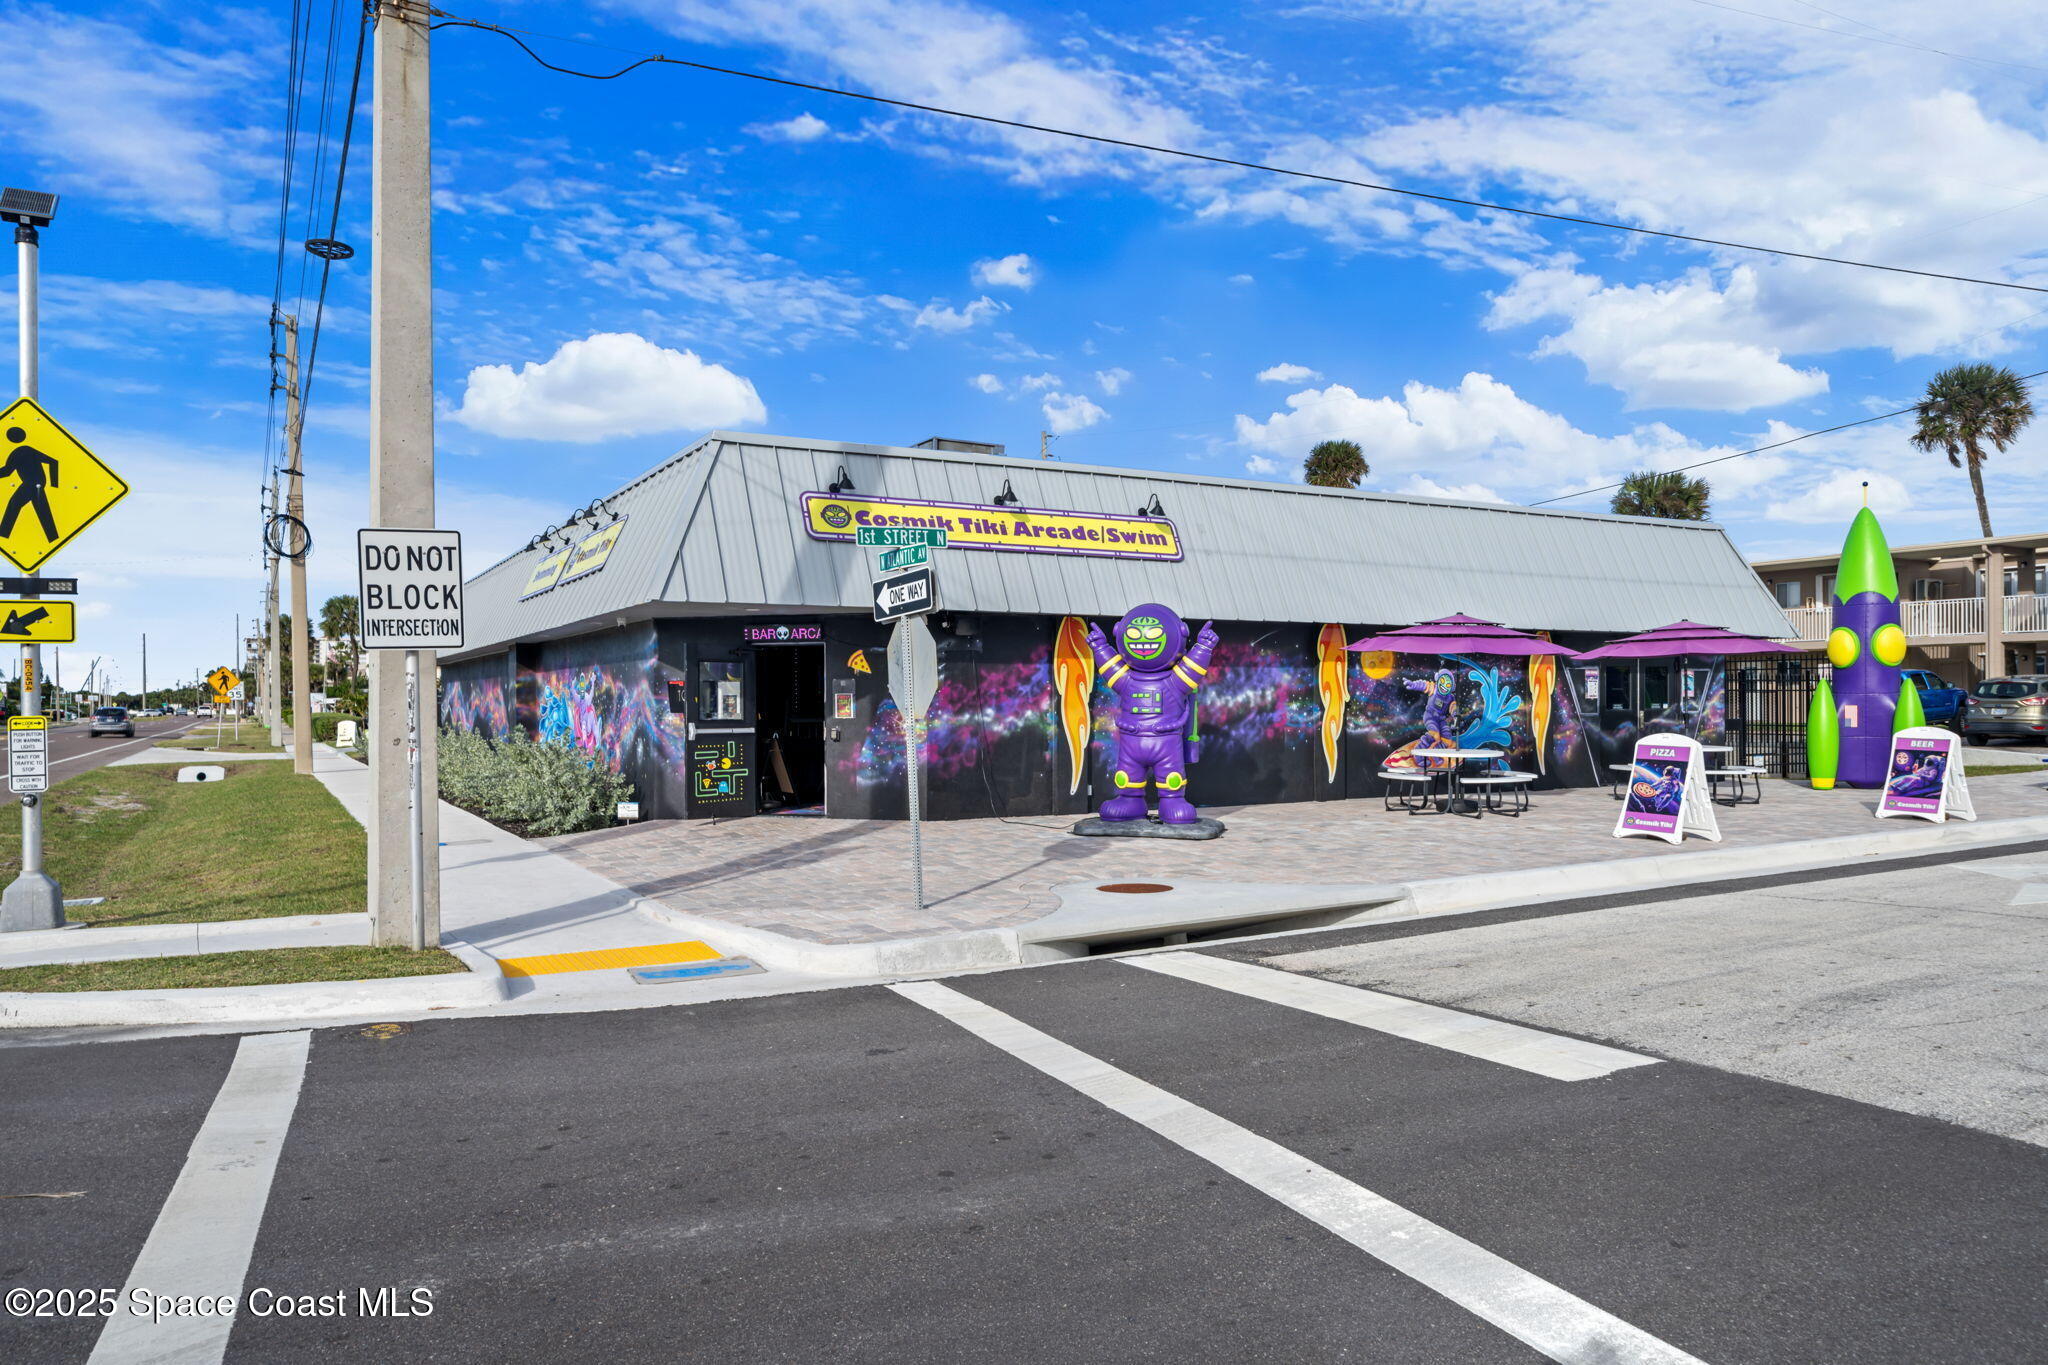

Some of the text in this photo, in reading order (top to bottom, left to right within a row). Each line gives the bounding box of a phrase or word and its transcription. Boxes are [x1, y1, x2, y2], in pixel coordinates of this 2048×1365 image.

[855, 510, 954, 531] Cosmik
[958, 517, 1007, 536] Tiki
[859, 529, 944, 546] 1st STREET N
[365, 545, 457, 571] DO NOT
[880, 546, 926, 572] N ATLANTIC AV
[367, 584, 459, 610] BLOCK
[889, 581, 924, 605] ONE WAY
[367, 619, 459, 637] INTERSECTION
[752, 628, 776, 640] BAR
[25, 659, 33, 691] BC-0454
[1650, 748, 1675, 757] PIZZA
[1910, 740, 1934, 748] BEER
